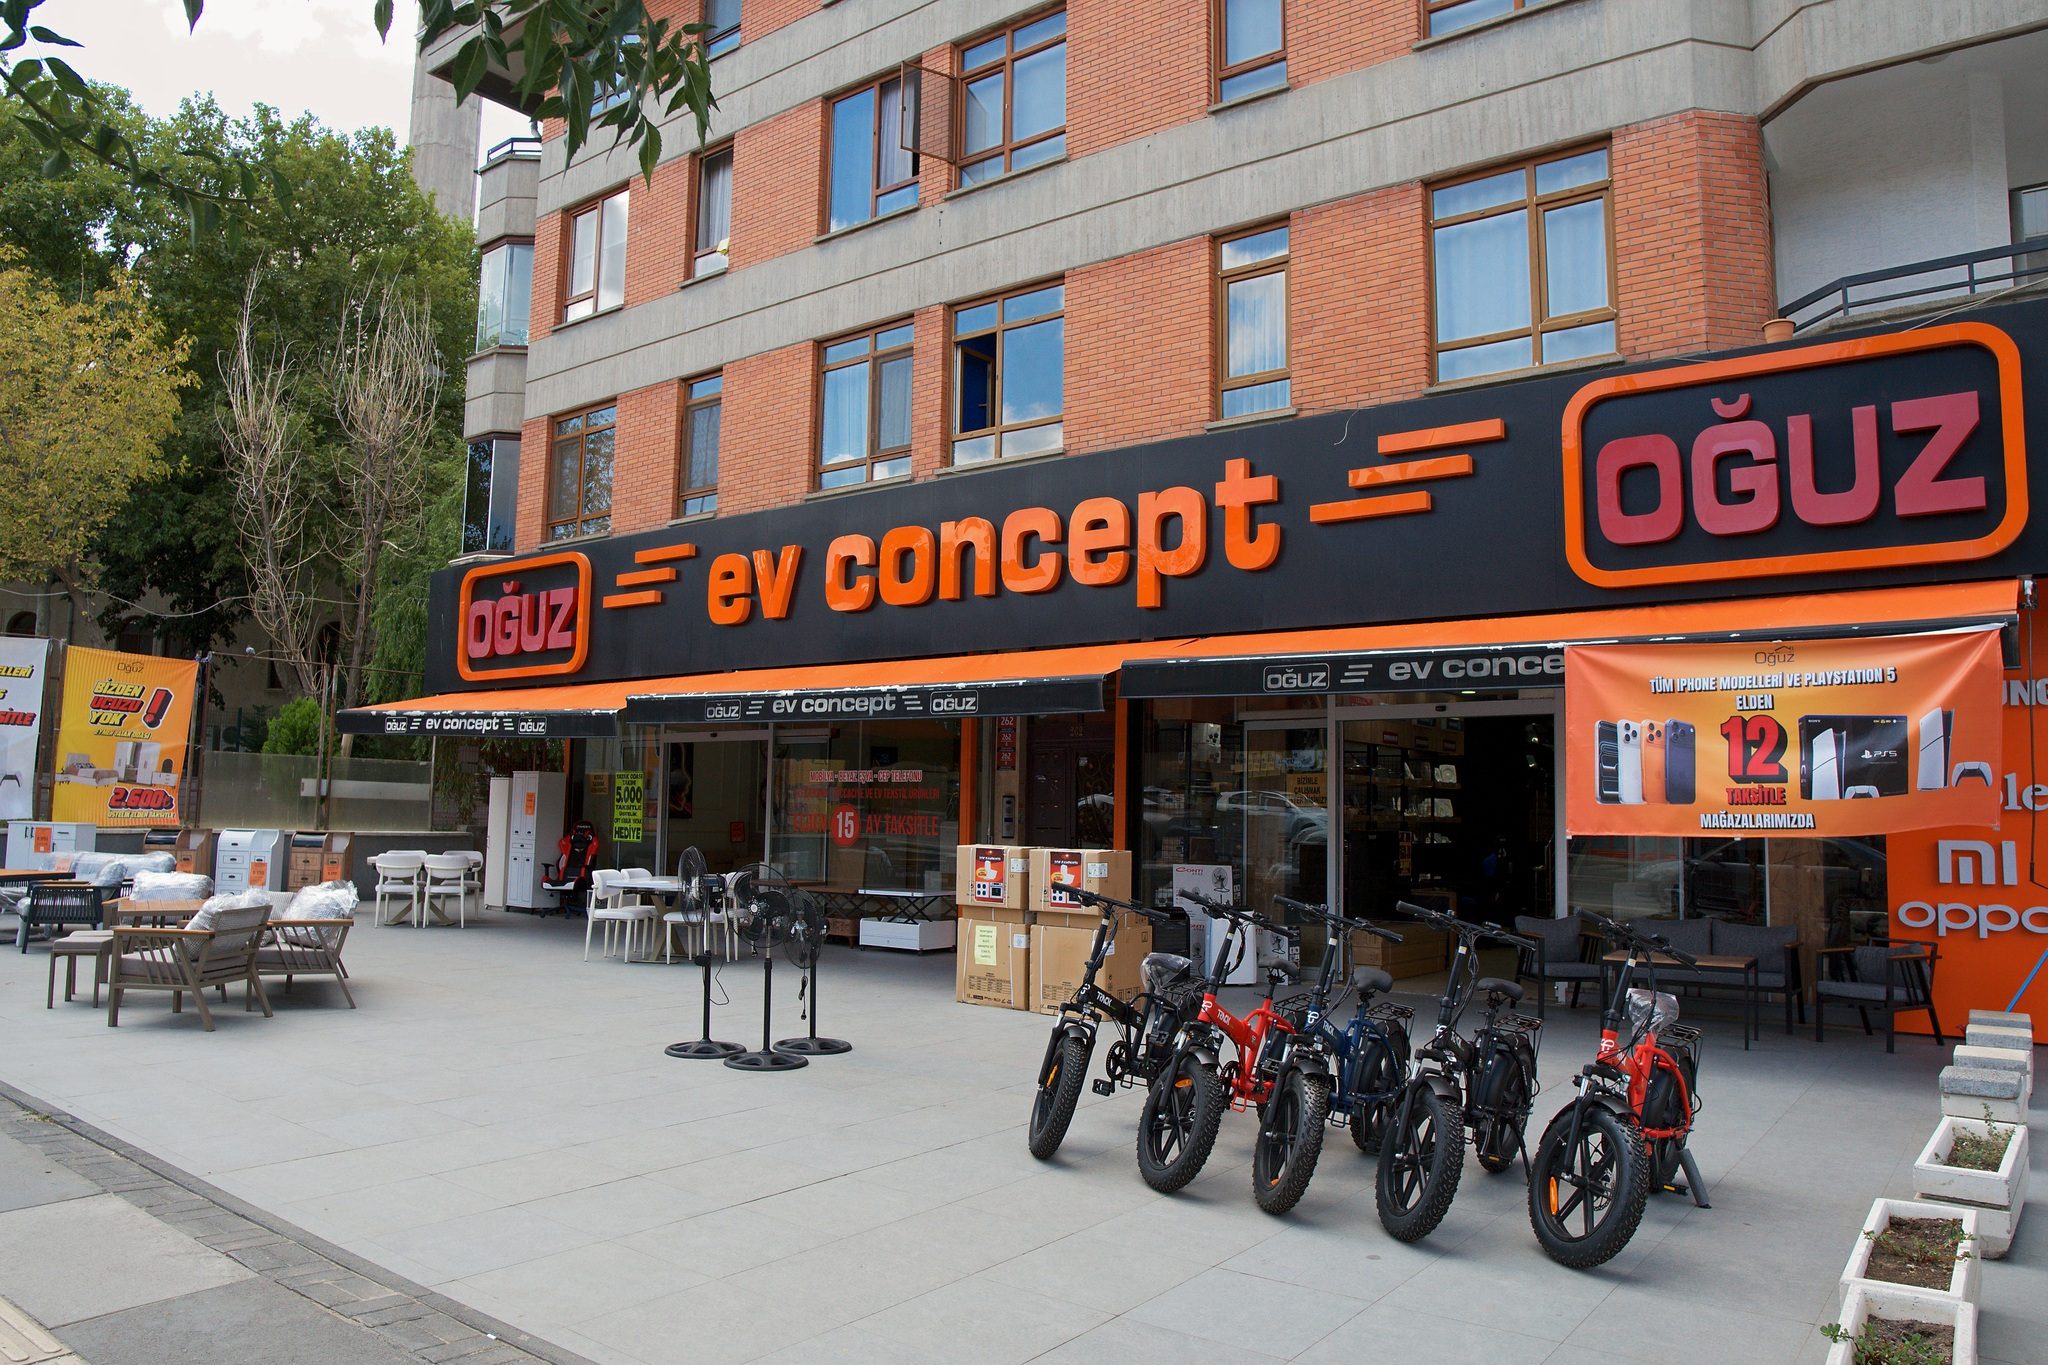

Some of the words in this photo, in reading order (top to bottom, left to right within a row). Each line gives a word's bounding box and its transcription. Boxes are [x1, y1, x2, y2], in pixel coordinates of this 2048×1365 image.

[1595, 391, 1987, 547] OĞUZ
[706, 544, 802, 626] ev
[824, 457, 1282, 610] concept
[467, 580, 577, 659] OĞUZ
[1754, 649, 1795, 667] Oğuz
[1266, 668, 1327, 689] OĞUZ
[1388, 660, 1434, 681] ev
[1650, 676, 1675, 694] TÜM
[1677, 676, 1717, 692] IPHONE
[1719, 671, 1784, 690] MODELLERİ
[1786, 672, 1802, 687] VE
[1804, 668, 1884, 687] PLAYSTATION
[1886, 667, 1897, 683] 5
[93, 678, 146, 698] BİZDEN
[90, 695, 145, 713] UCUZU
[706, 703, 739, 718] OĞUZ
[772, 699, 798, 713] ev
[801, 693, 897, 716] concept
[932, 694, 977, 711] OĞUZ
[1736, 694, 1774, 711] ELDEN
[89, 710, 127, 726] YOK
[386, 719, 407, 731] OĞUZ
[425, 719, 441, 730] ev
[442, 717, 499, 733] concept
[519, 719, 545, 732] OĞUZ
[1000, 716, 1014, 726] 262
[1721, 714, 1788, 784] 12
[1873, 750, 1898, 758] PS5
[858, 770, 873, 784] EŞYA
[877, 769, 890, 782] CEP
[891, 769, 923, 782] TELEFONU
[616, 786, 643, 803] 5.000
[1726, 785, 1787, 805] TAKSİTLE
[836, 811, 854, 838] 15
[865, 815, 881, 833] AY
[884, 812, 939, 836] TAKSİTLE
[1700, 810, 1816, 829] MAĞAZALARIMIZDA
[614, 824, 641, 840] HEDİYE
